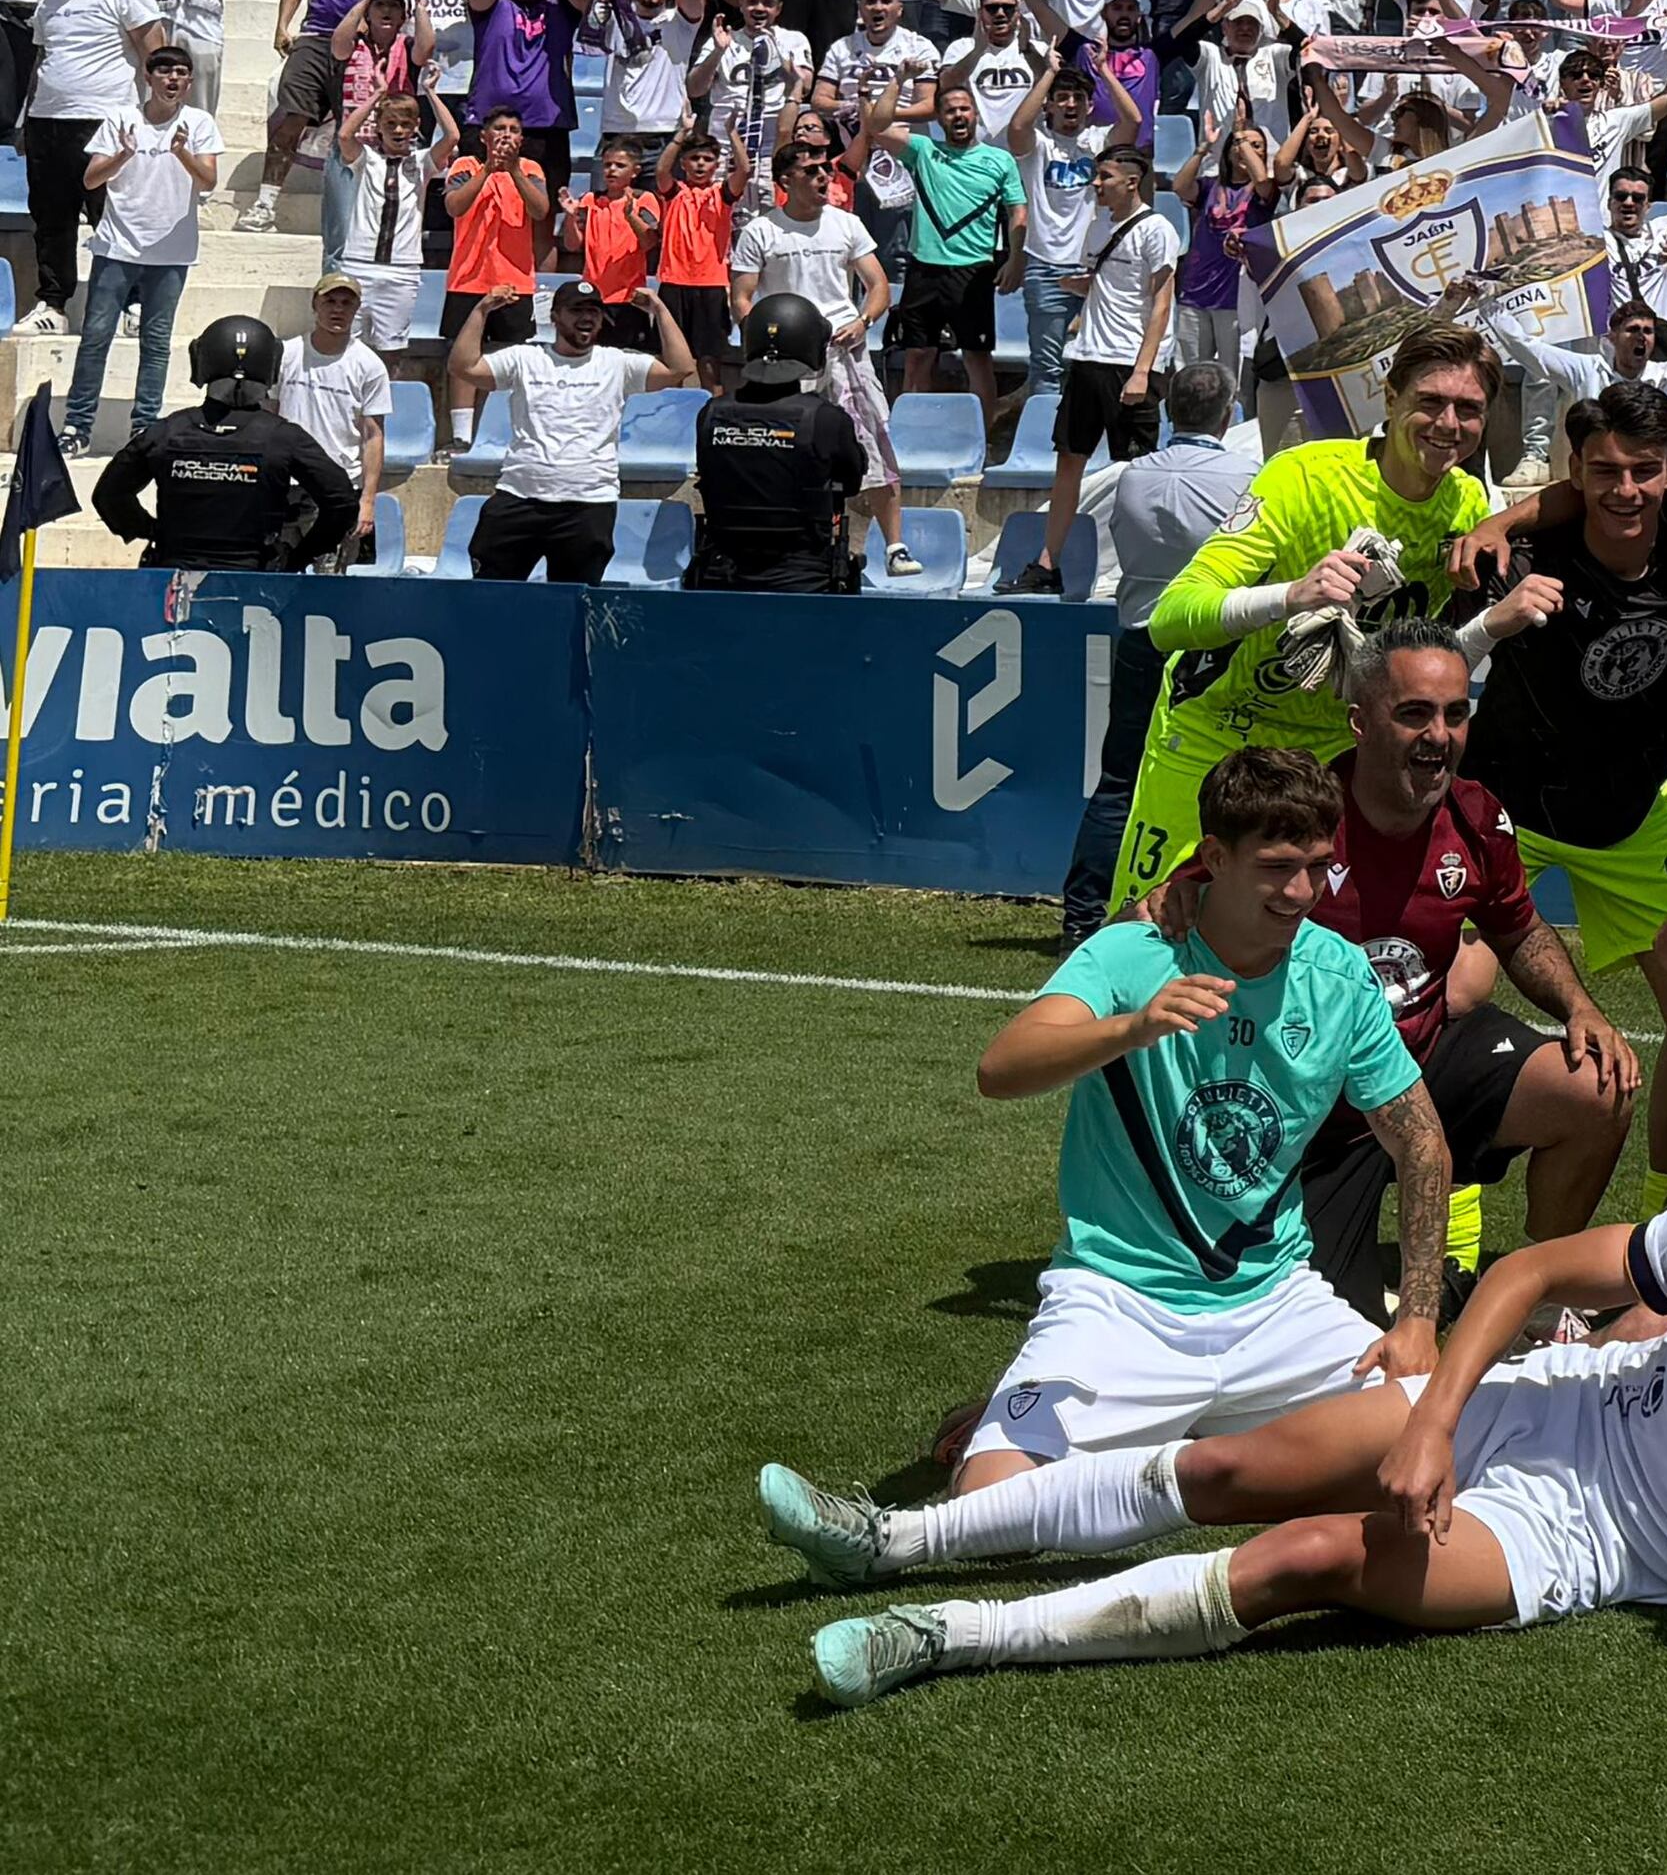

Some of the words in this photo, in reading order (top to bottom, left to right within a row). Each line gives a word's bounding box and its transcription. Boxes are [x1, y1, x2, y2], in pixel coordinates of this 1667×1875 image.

[711, 435, 795, 450] NACIONAL
[169, 468, 259, 484] NACIONAL
[198, 768, 452, 833] médico
[1127, 820, 1169, 877] 13
[1227, 1016, 1257, 1047] 30
[1186, 1087, 1276, 1132] GIULIETTA
